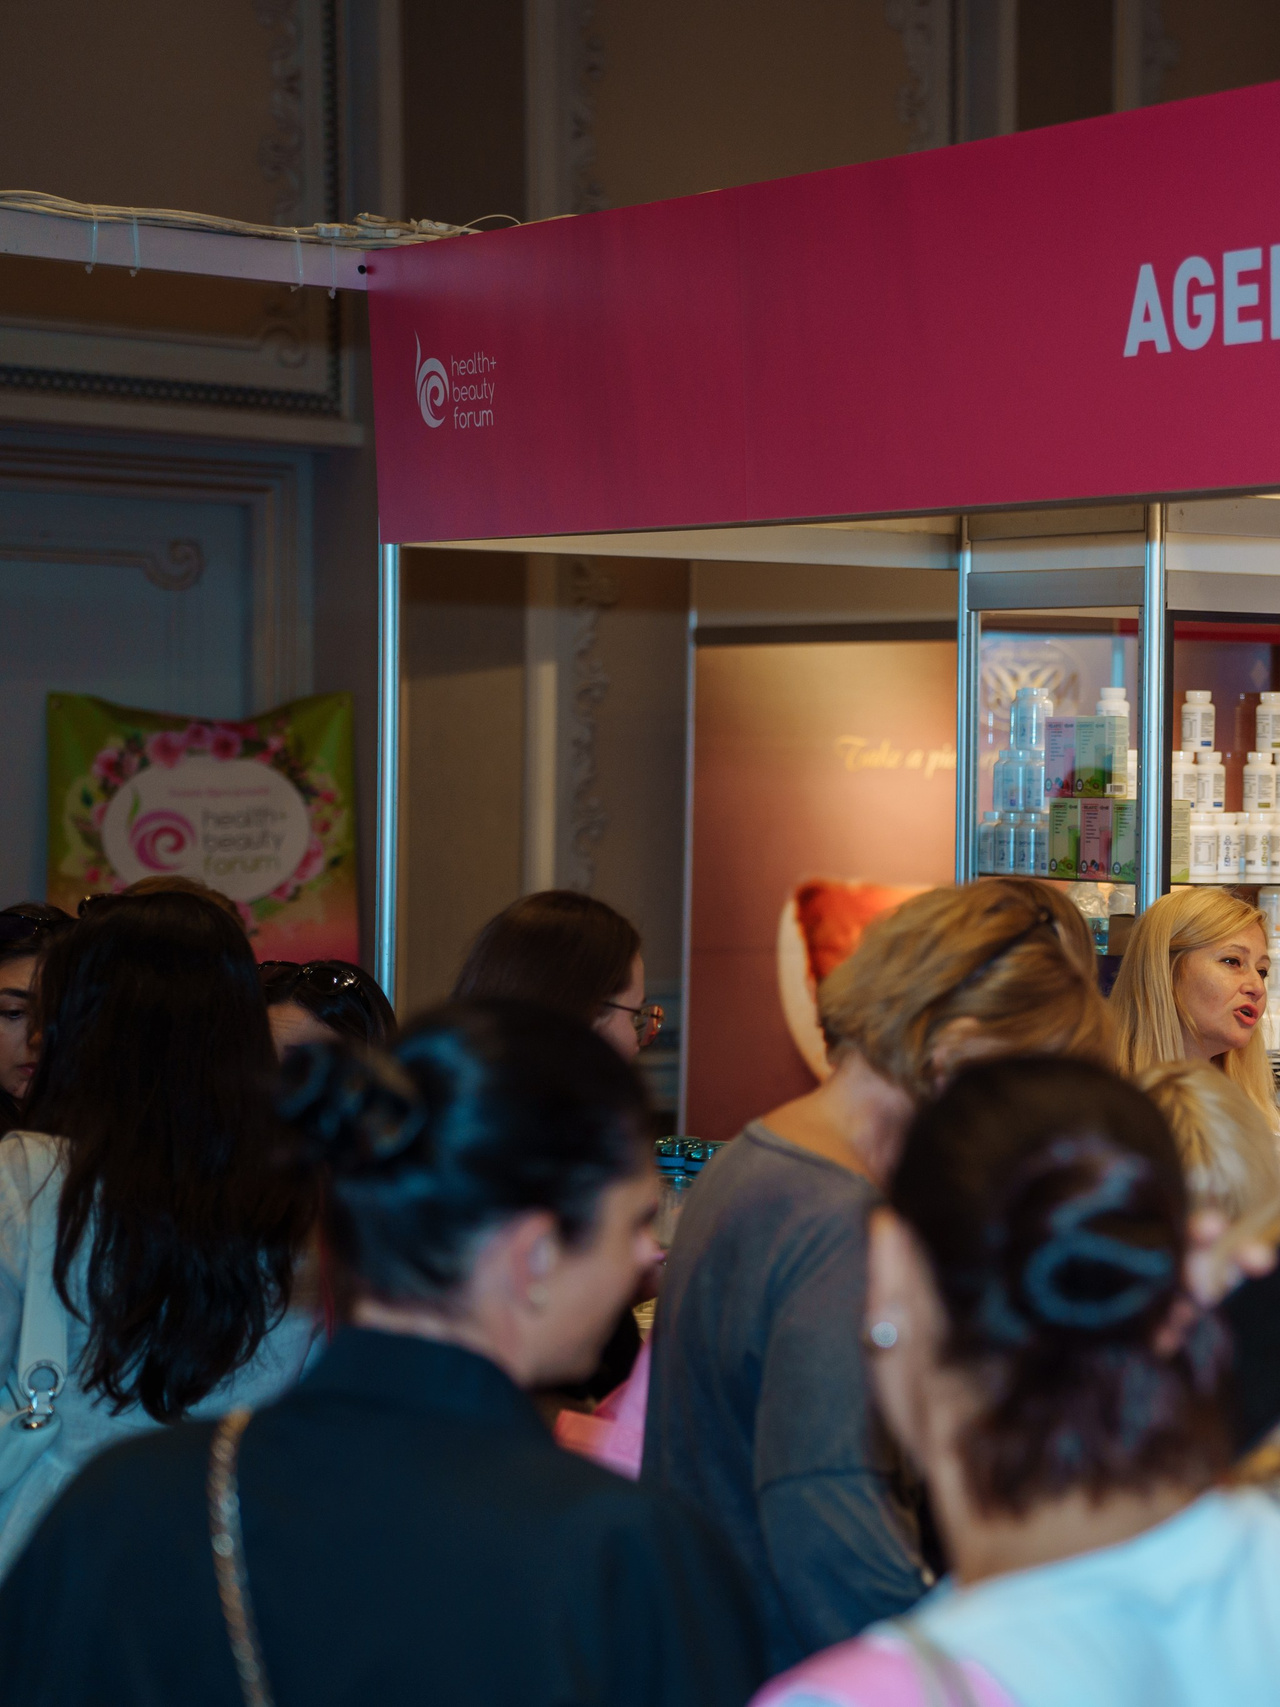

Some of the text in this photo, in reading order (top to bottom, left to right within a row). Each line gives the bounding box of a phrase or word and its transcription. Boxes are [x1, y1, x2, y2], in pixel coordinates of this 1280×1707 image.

[451, 351, 497, 376] health+
[452, 377, 495, 405] beauty
[453, 406, 494, 429] forum
[202, 831, 287, 854] beauty
[203, 855, 282, 877] forum
